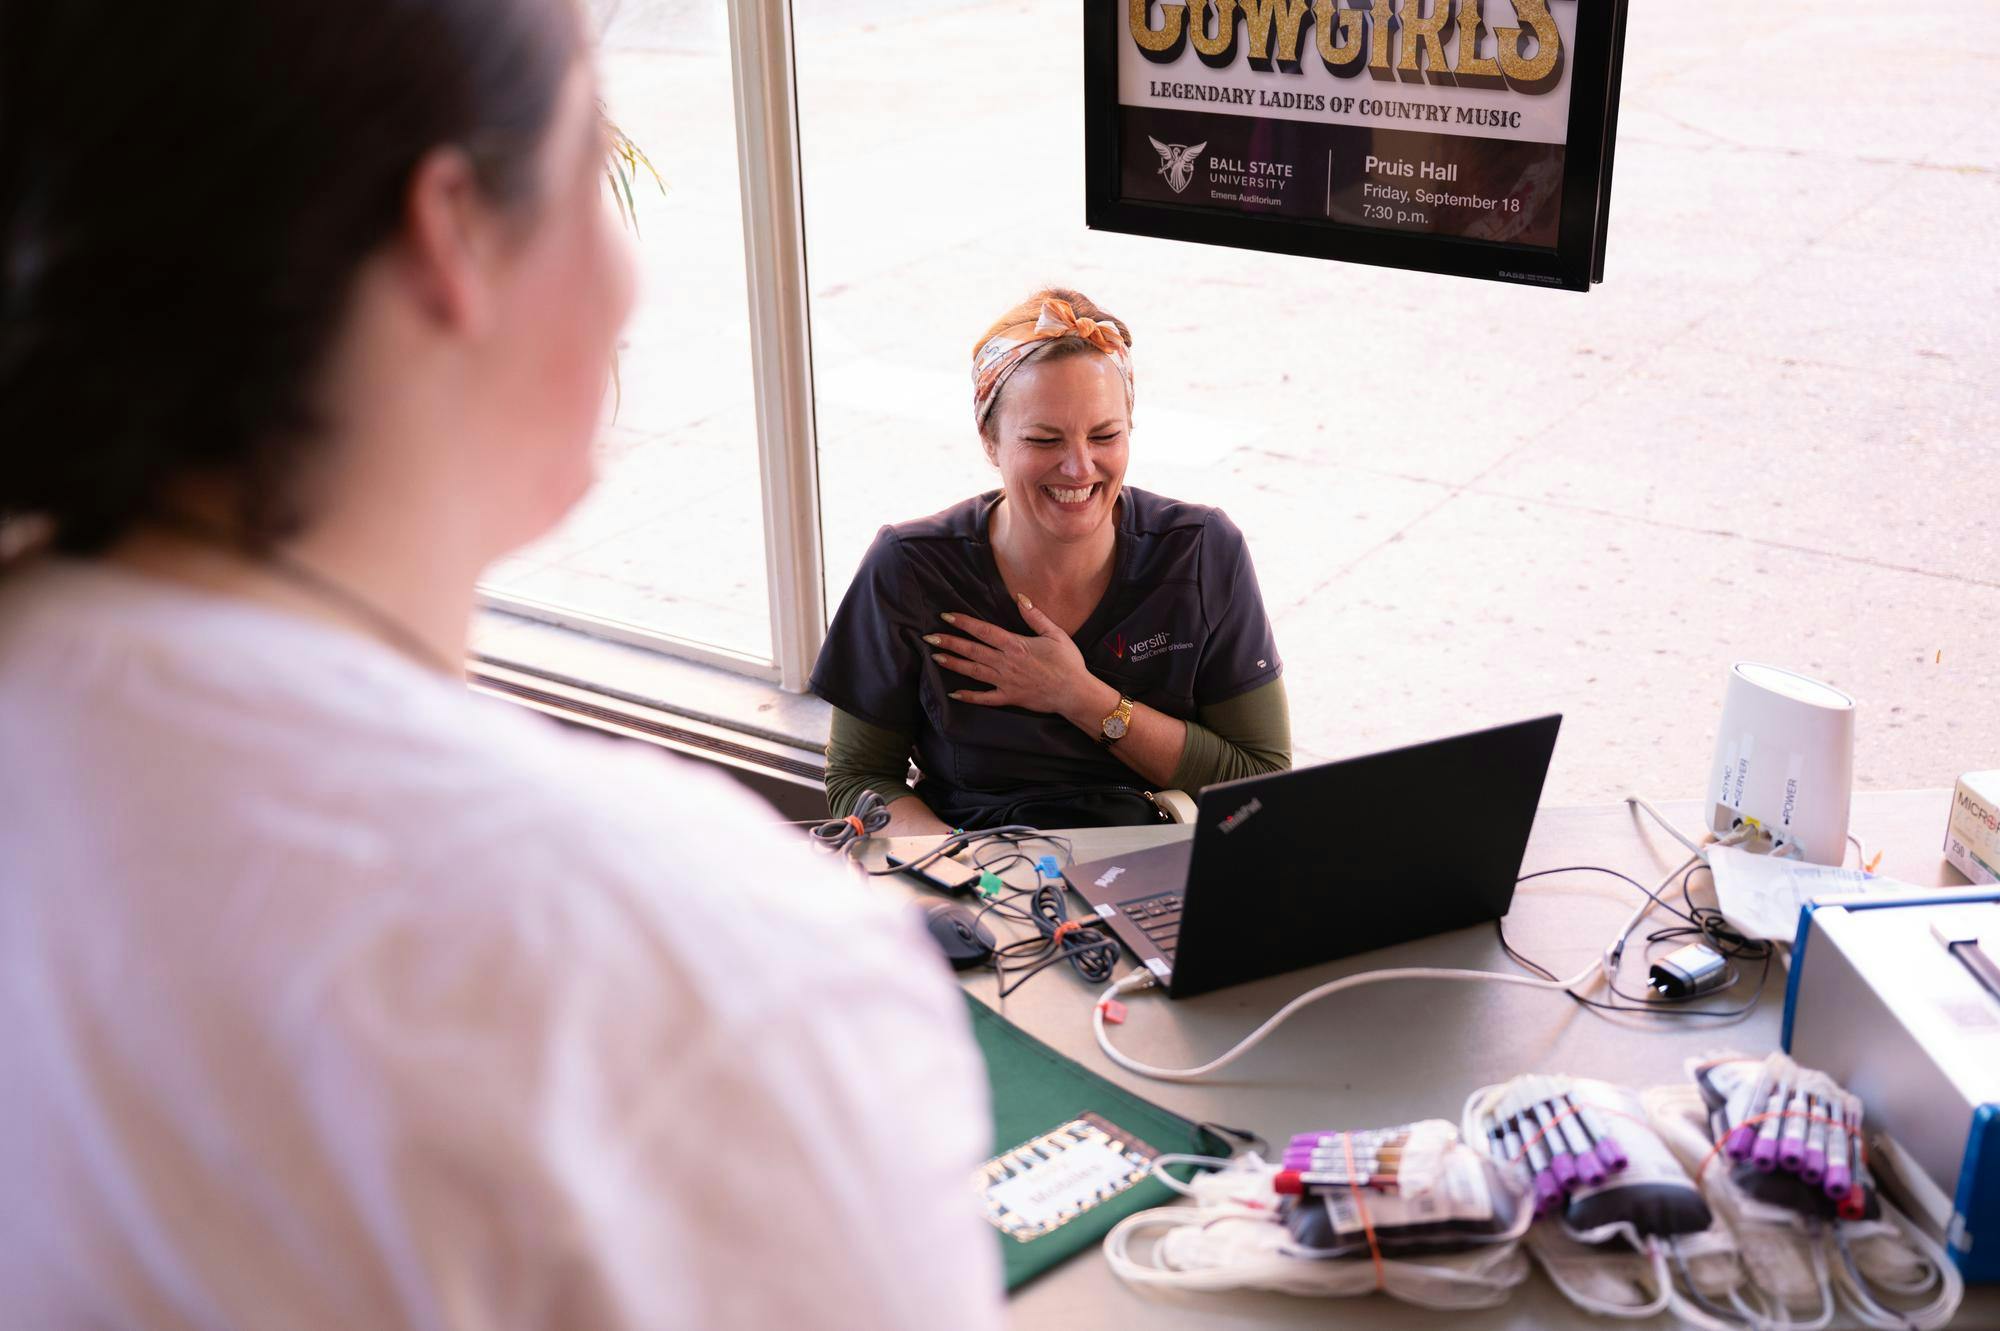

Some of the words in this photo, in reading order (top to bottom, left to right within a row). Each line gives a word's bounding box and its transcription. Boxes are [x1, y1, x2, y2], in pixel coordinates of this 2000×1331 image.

[1128, 0, 1563, 90] COWGIRLS
[1149, 81, 1256, 105] LEGENDARY
[1259, 90, 1325, 112] LADIES
[1329, 96, 1355, 114] OF
[1359, 99, 1453, 123] COUNTRY
[1455, 106, 1522, 129] MUSIC
[1209, 157, 1245, 172] BALL
[1249, 161, 1293, 177] STATE
[1365, 155, 1414, 178] Pruis
[1419, 160, 1458, 182] Hall
[1209, 172, 1286, 190] UNIVERSITY
[1210, 190, 1237, 201] Emens
[1238, 193, 1281, 206] Auditorium
[1363, 183, 1411, 204] Friday,
[1415, 188, 1498, 211] September
[1501, 198, 1521, 213] 18
[1362, 204, 1393, 220] 7:30
[1397, 210, 1429, 224] p.m.
[1783, 778, 1797, 819] POWER
